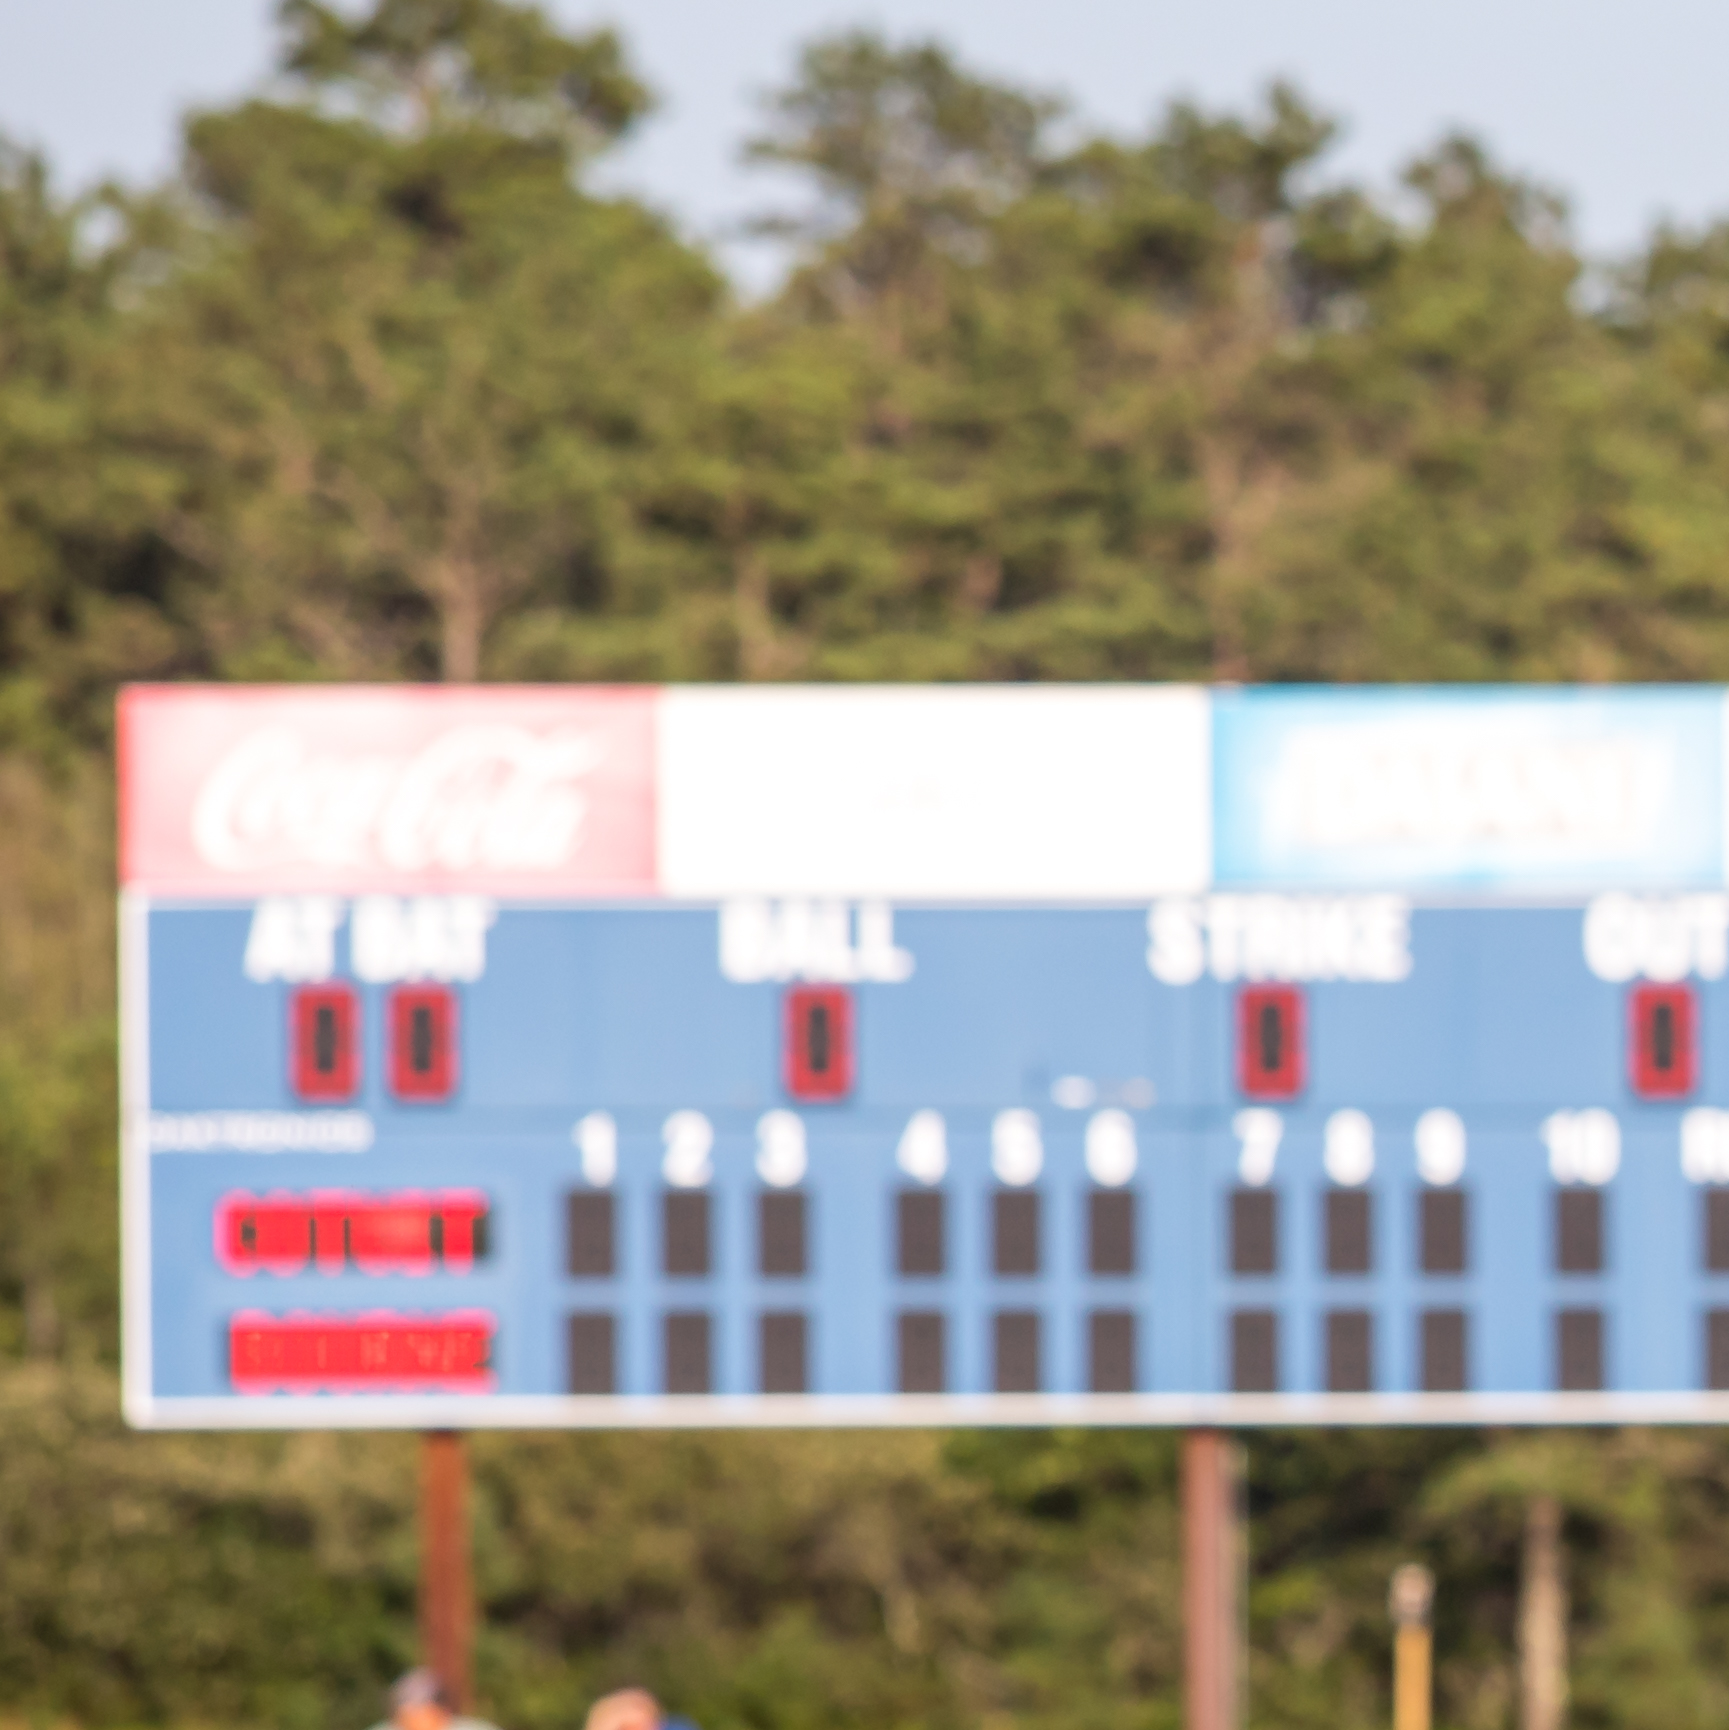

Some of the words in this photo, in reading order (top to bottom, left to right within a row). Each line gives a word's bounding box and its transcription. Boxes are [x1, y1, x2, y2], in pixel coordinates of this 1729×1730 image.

[243, 895, 344, 983] AT
[718, 895, 914, 983] BALL
[1146, 895, 1412, 984] STRIKE
[783, 981, 857, 1102] 0
[1237, 981, 1306, 1100] 0
[1628, 981, 1699, 1100] 0
[573, 1110, 618, 1188] 1
[660, 1109, 714, 1189] 2
[754, 1108, 808, 1189] 3
[1231, 1106, 1284, 1187] 7
[1538, 1106, 1622, 1186] 10
